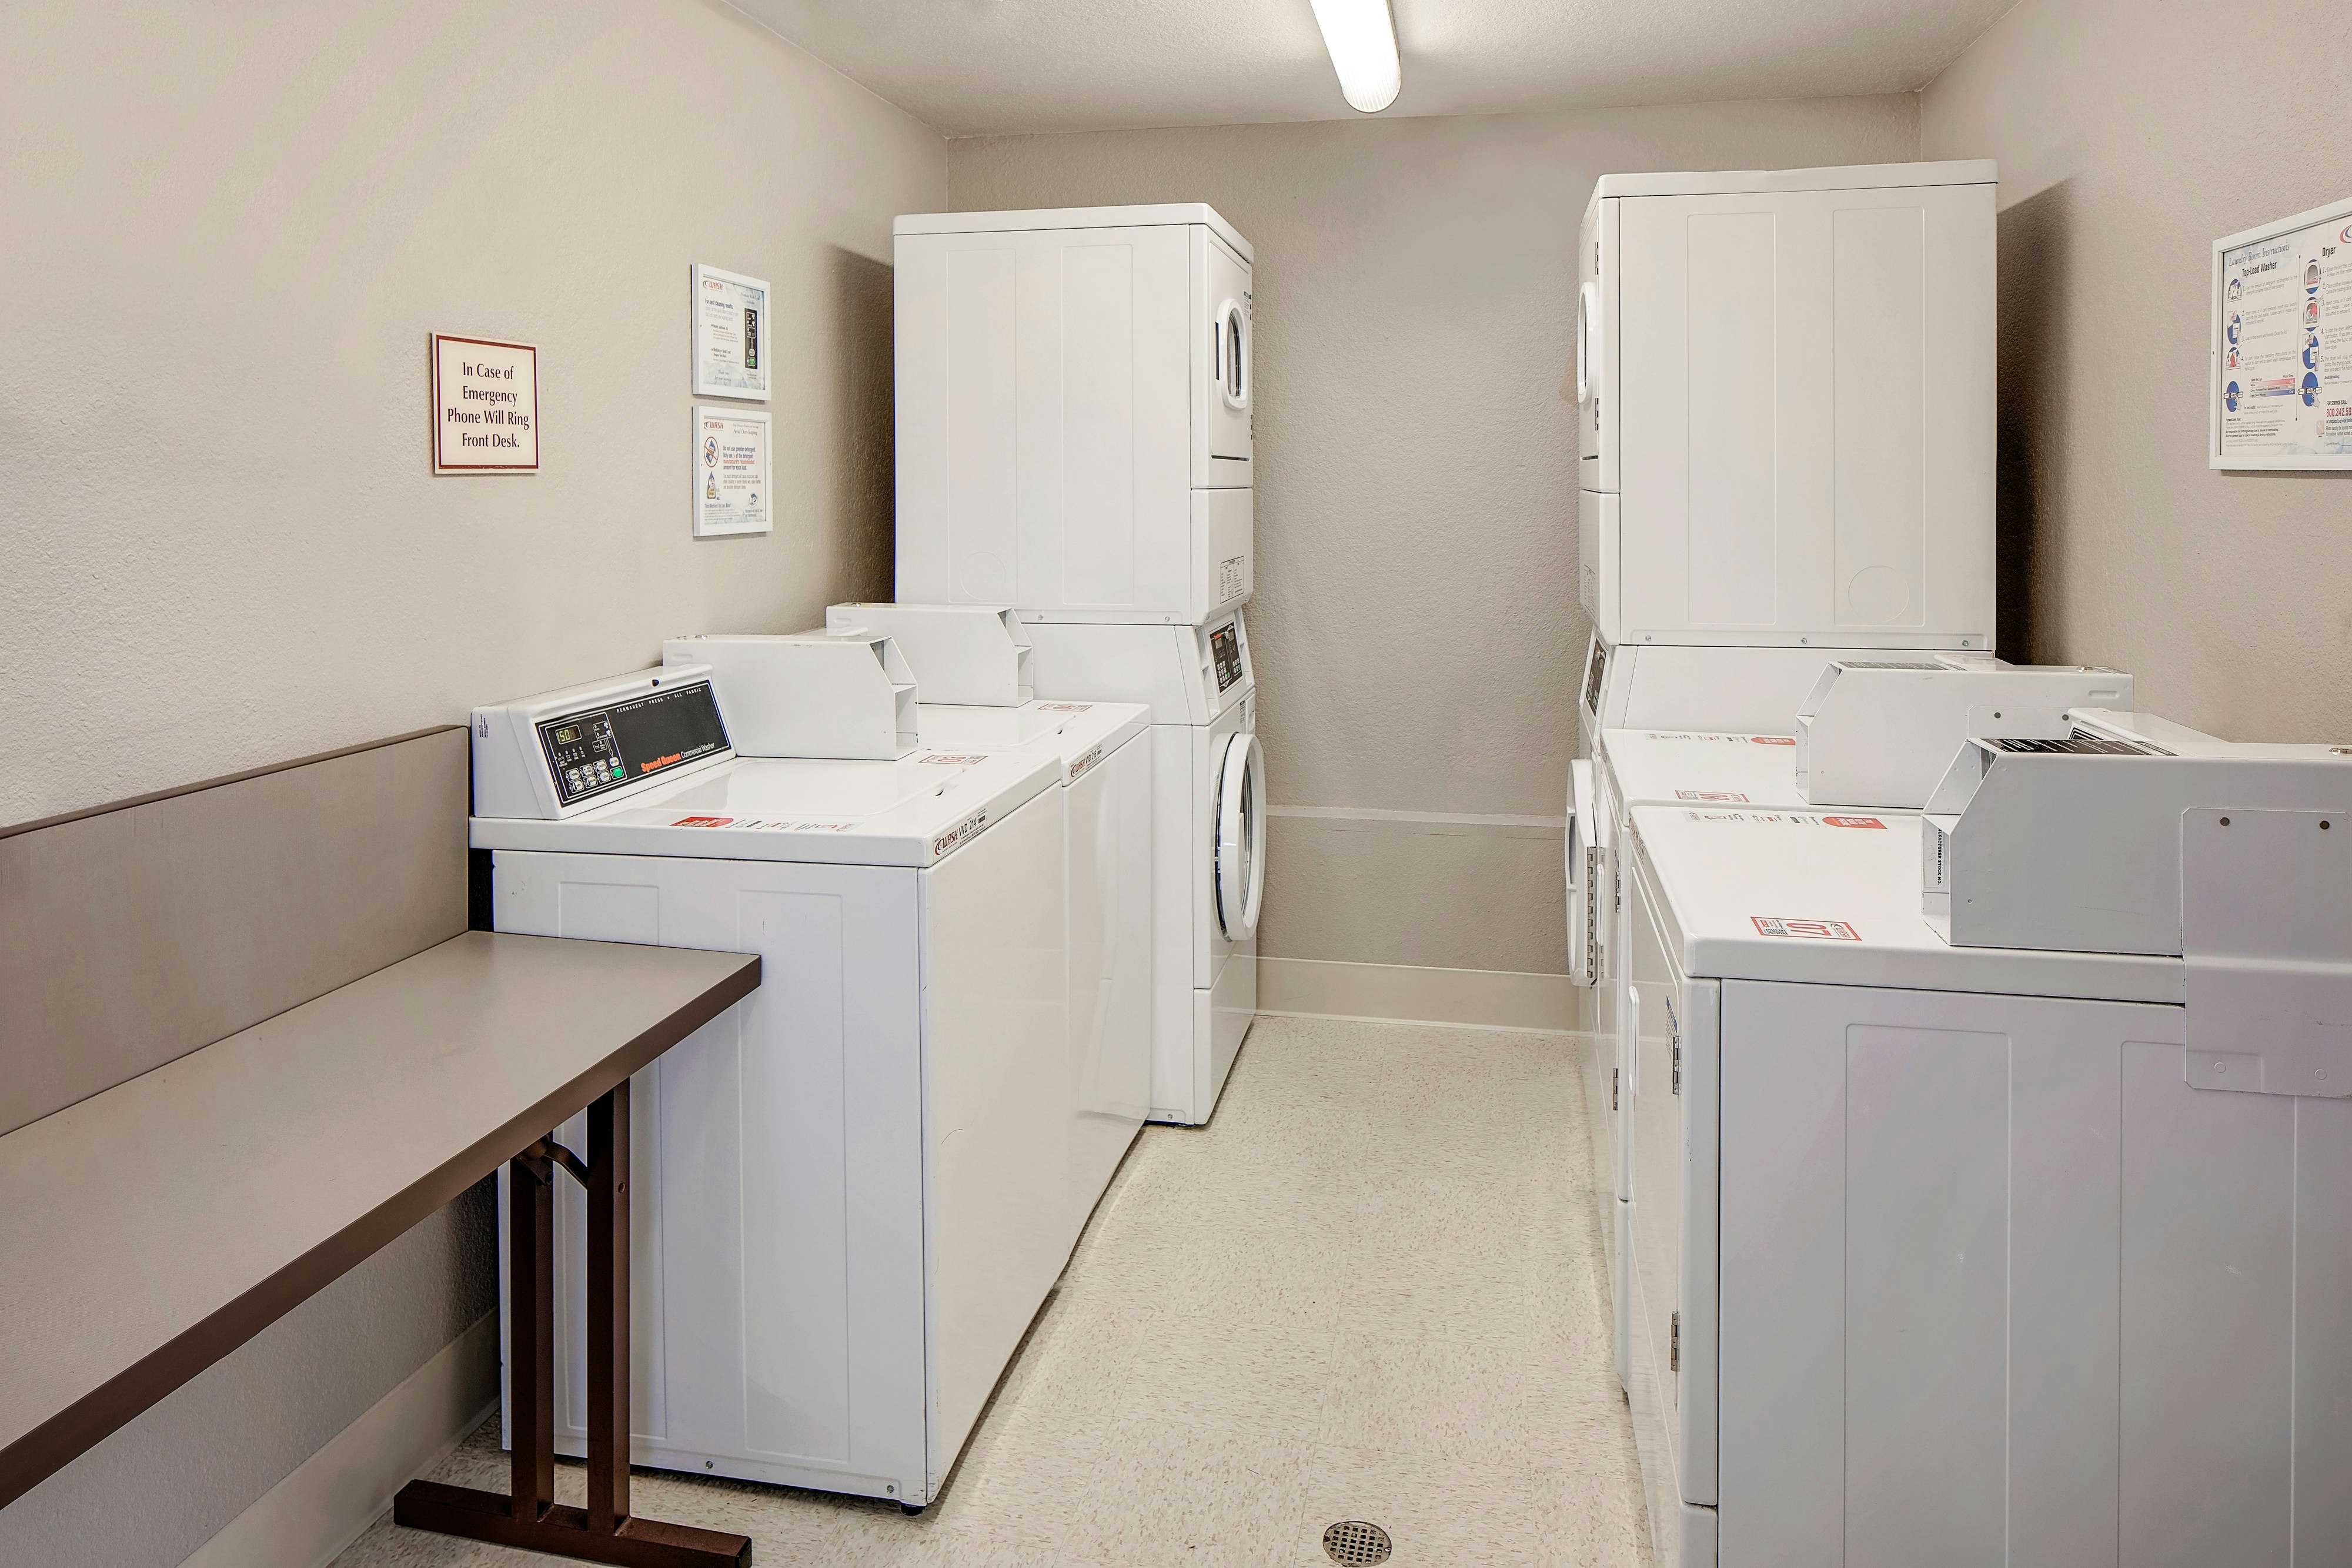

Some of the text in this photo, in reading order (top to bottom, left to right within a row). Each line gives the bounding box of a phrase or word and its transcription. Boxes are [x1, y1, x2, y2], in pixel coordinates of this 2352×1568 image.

[2229, 244, 2290, 266] Laundry Room Instructions
[2322, 246, 2336, 258] Dryer
[2241, 262, 2277, 278] Top-Load Washer
[709, 281, 723, 290] WASH
[463, 362, 514, 380] In Case of
[463, 386, 517, 407] Emergency
[447, 407, 529, 430] Phone Will Ring
[2326, 407, 2352, 417] 800.342.59
[462, 433, 520, 447] Front Desk.
[616, 703, 644, 713] PERMANENT
[641, 742, 715, 773] Speed Queen Commercial Washer
[943, 829, 958, 848] WASH
[1786, 922, 1832, 936] 07
